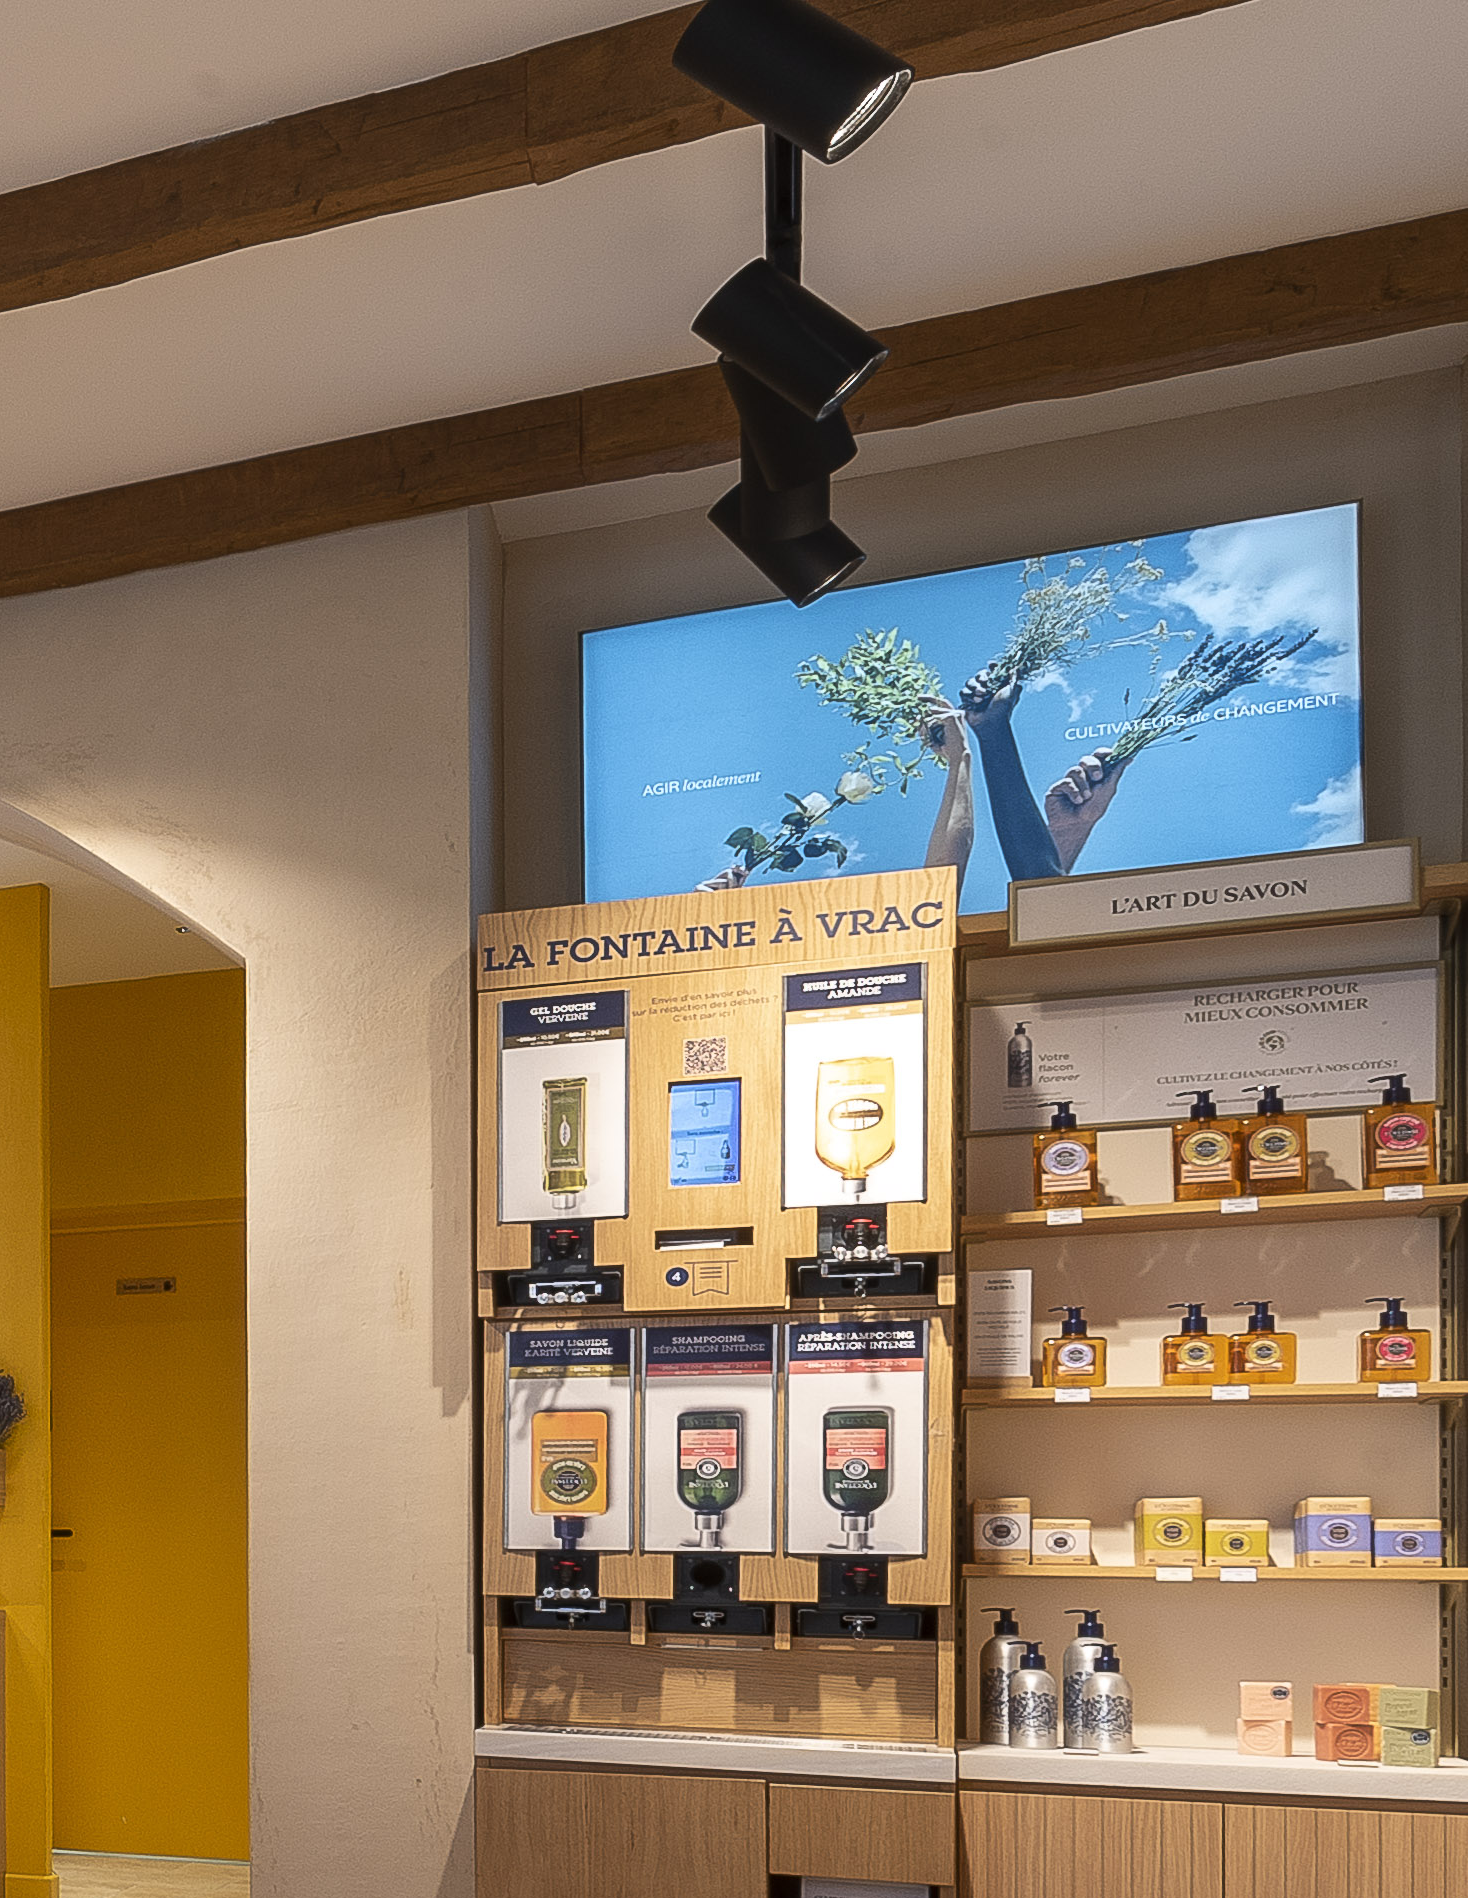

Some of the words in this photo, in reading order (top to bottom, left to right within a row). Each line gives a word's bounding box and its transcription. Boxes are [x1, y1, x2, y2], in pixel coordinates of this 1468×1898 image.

[1064, 714, 1187, 742] CULTIVATEURS
[1190, 709, 1210, 725] de
[1212, 692, 1341, 723] CHANGEMENT
[642, 780, 681, 797] AGIR
[682, 769, 761, 793] localement
[1111, 893, 1177, 915] L'ART
[1183, 889, 1218, 908] DU
[1223, 880, 1308, 903] SAVON
[483, 944, 535, 972] LA
[547, 920, 757, 967] FONTAINE
[769, 907, 802, 944] À
[815, 901, 946, 939] VRAC
[803, 980, 835, 993] HUILE
[837, 979, 856, 990] DE
[858, 974, 907, 988] DOUCHE
[827, 985, 882, 999] AMANDE
[1193, 986, 1303, 1007] RECHARGER
[1307, 982, 1359, 997] POUR
[530, 1005, 551, 1016] GEL
[552, 1002, 596, 1015] DOUCHE
[1183, 1008, 1243, 1024] MIEUX
[1245, 997, 1369, 1020] CONSOMMER
[537, 1012, 589, 1024] VERVEINE
[1038, 1053, 1069, 1062] Votre
[1038, 1063, 1074, 1073] flacon
[1038, 1074, 1080, 1083] forever
[671, 1271, 682, 1281] 4
[529, 1339, 564, 1349] SAVON
[566, 1338, 609, 1348] LIQUIDE
[672, 1335, 746, 1344] SHAMPOOING
[797, 1340, 866, 1352] RÉPARATION
[870, 1339, 916, 1351] INTENSE
[524, 1347, 562, 1358] KARITÉ
[564, 1347, 614, 1357] VERVEINE
[653, 1342, 711, 1354] RÉPARATION
[713, 1343, 766, 1353] INTENSE
